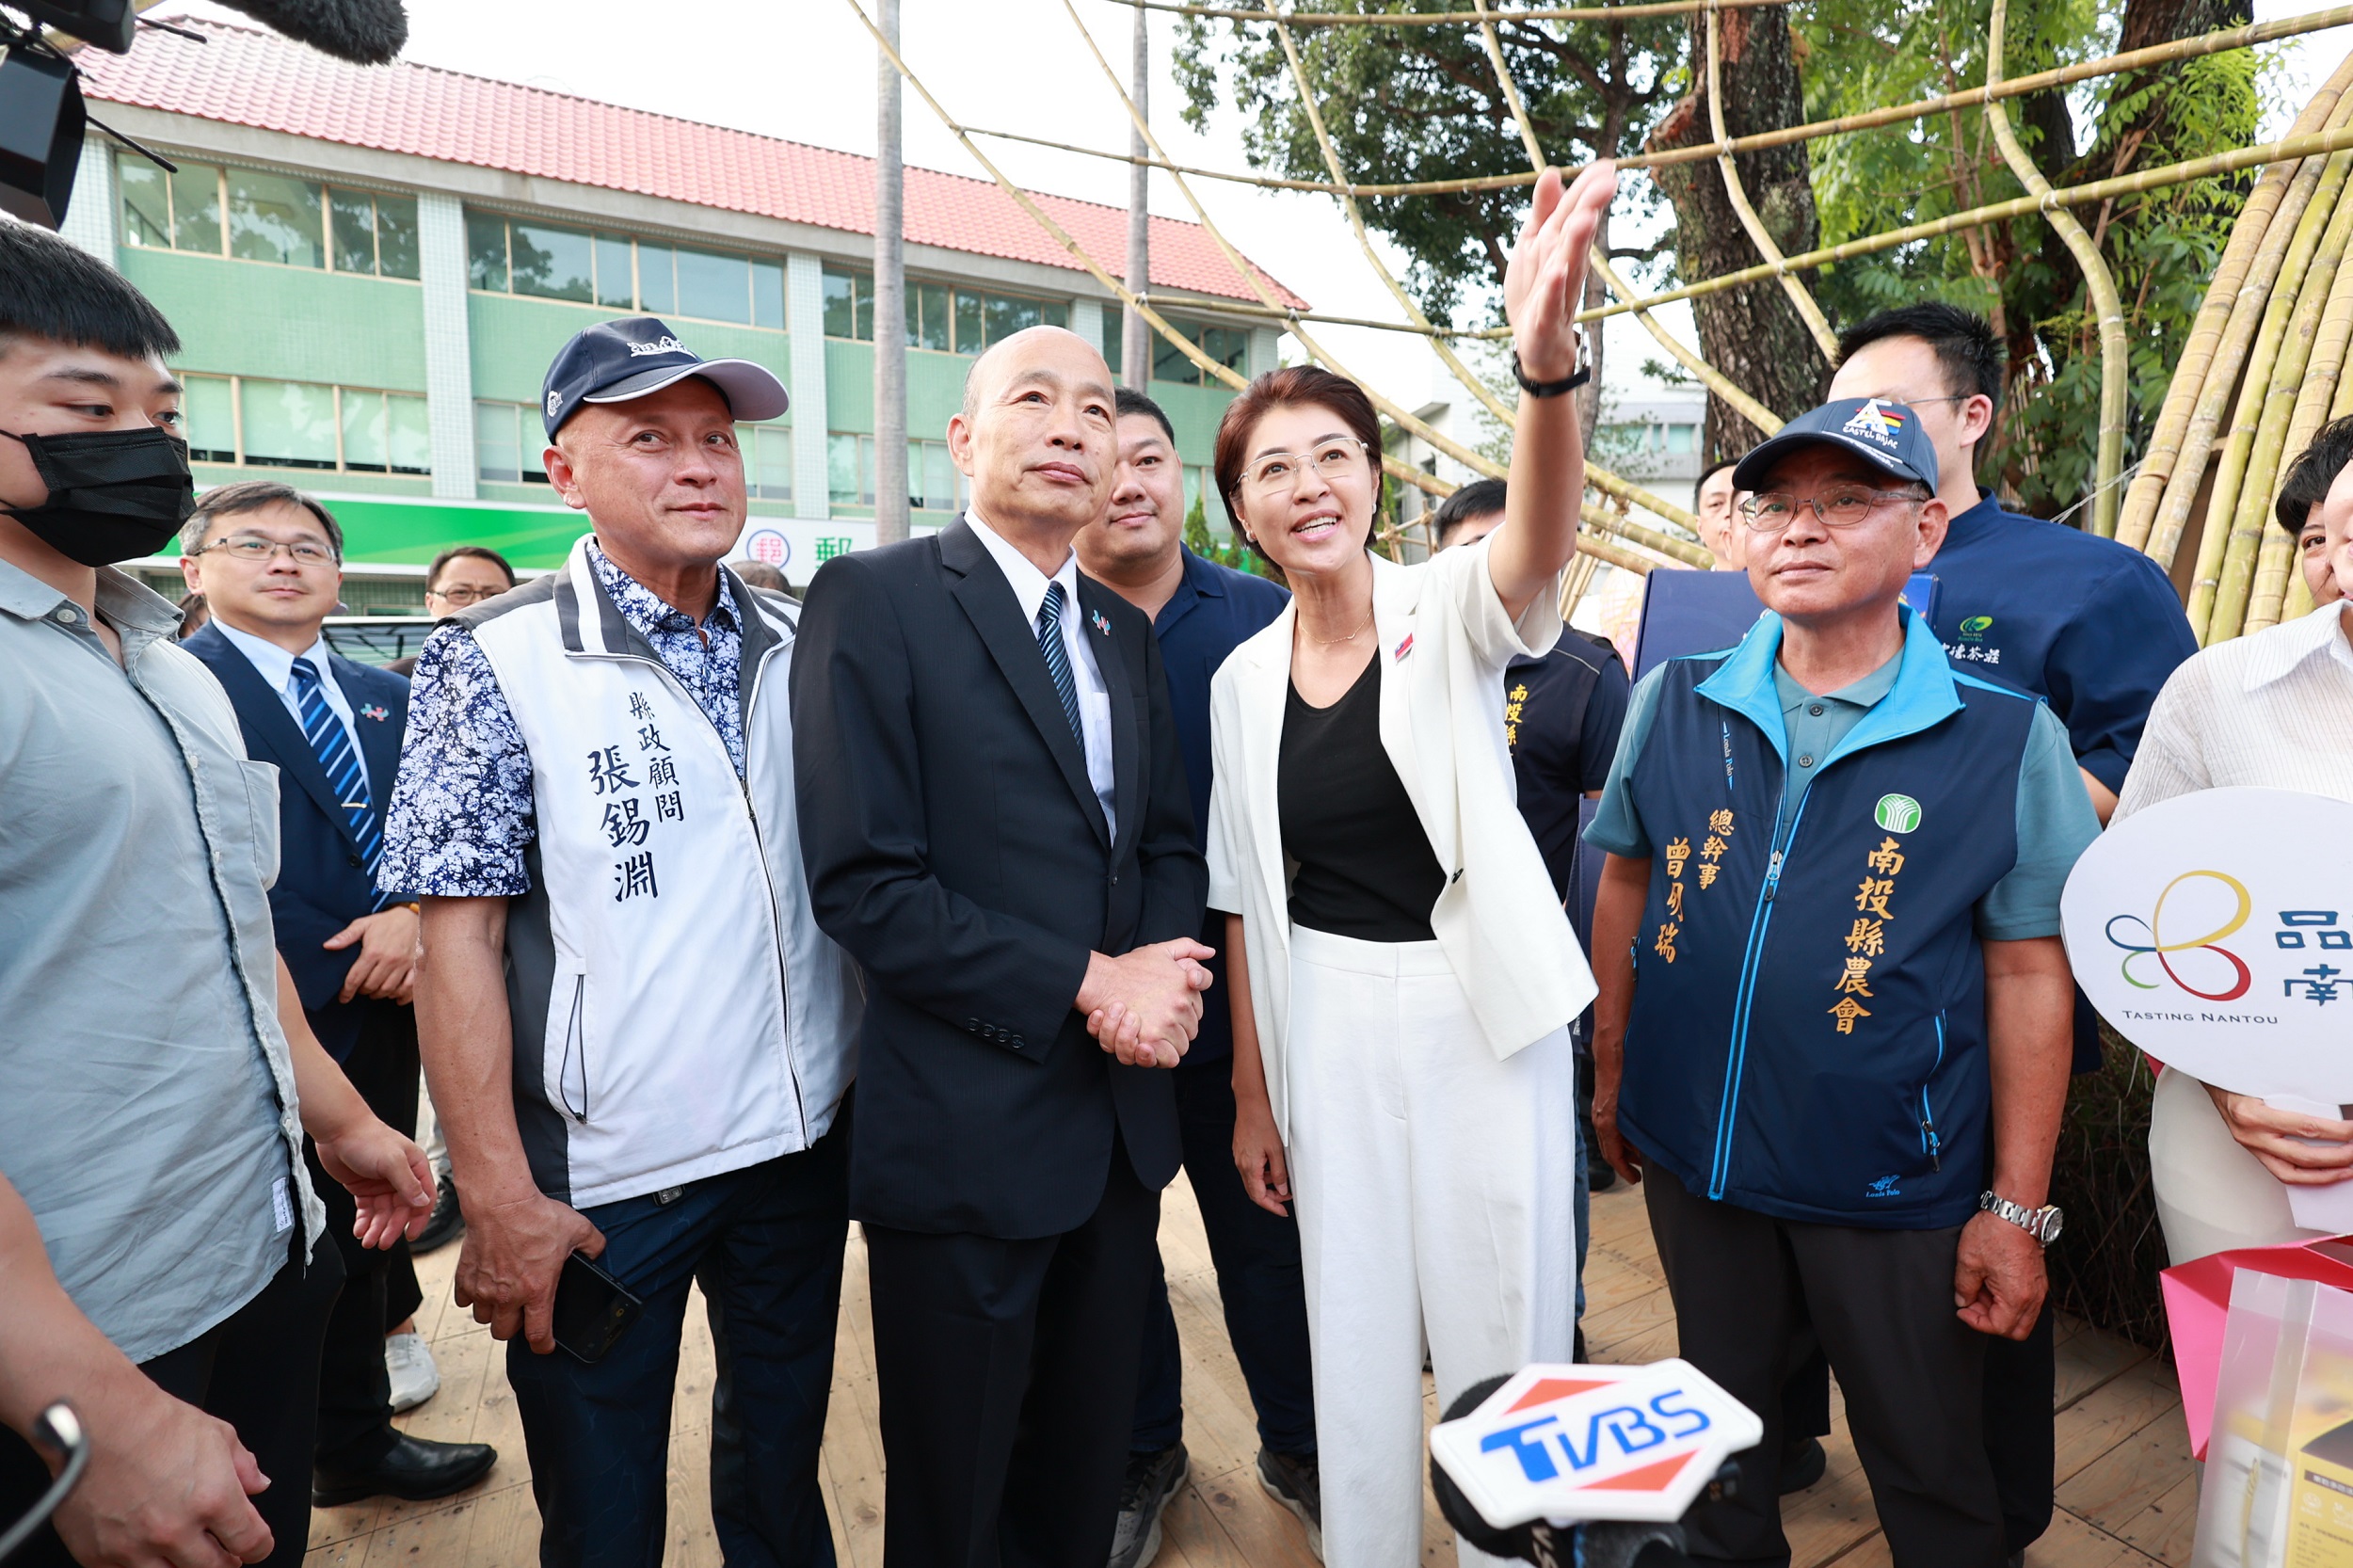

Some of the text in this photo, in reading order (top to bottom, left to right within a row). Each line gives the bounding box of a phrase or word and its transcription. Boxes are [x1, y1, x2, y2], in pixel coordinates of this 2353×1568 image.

[629, 692, 684, 824] 縣政顧問
[586, 744, 659, 903] 張錫淵
[1698, 808, 1735, 890] 總幹事
[1654, 837, 1692, 965] 曾明瑞
[1828, 836, 1906, 1035] 南投縣農會
[2275, 910, 2353, 950] 品
[2121, 1009, 2279, 1025] TASTING NANTOU
[2283, 963, 2353, 1007] 南
[1480, 1388, 1711, 1482] TVBS
